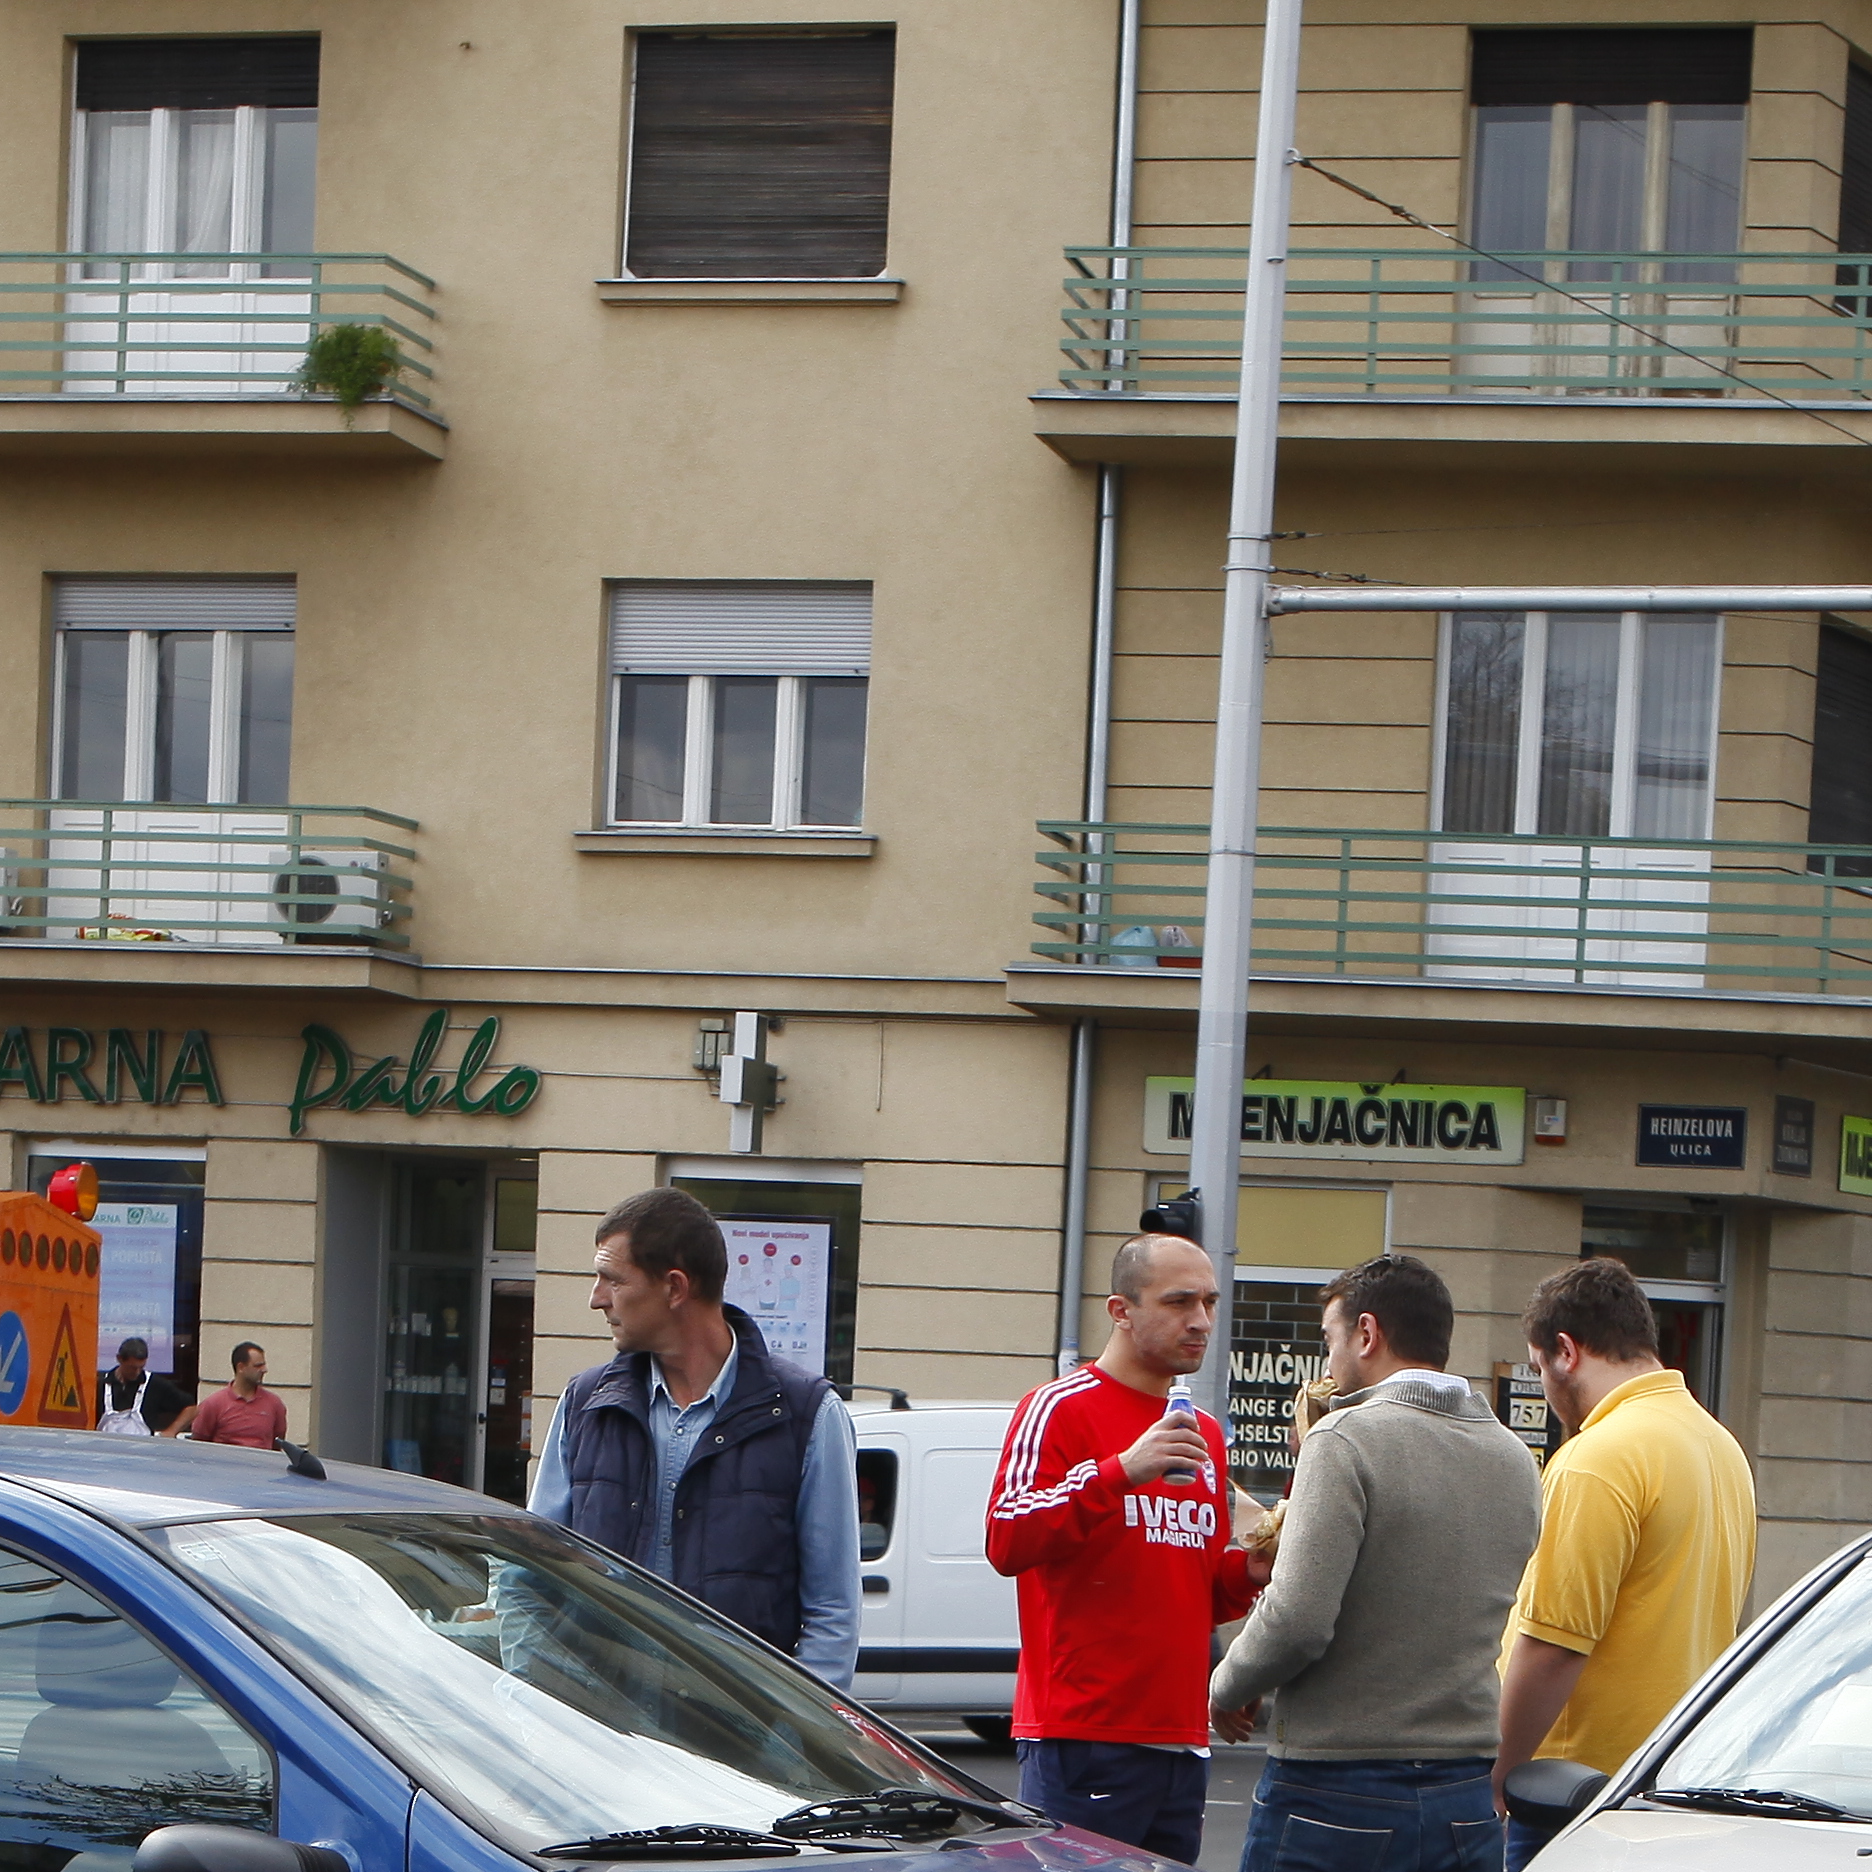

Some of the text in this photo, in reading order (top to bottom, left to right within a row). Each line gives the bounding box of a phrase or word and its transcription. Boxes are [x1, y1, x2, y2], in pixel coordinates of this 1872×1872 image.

[288, 1007, 544, 1137] Pablo
[1167, 1082, 1503, 1151] MENJAČNICA
[1650, 1117, 1733, 1138] HEINZELOVA
[1669, 1144, 1712, 1157] ULICA
[94, 1213, 121, 1223] ARNA
[1230, 1344, 1329, 1385] NJAČNI
[1228, 1397, 1277, 1418] ANGE
[1512, 1404, 1546, 1424] 757
[1233, 1422, 1291, 1445] HSELST
[1123, 1494, 1217, 1537] IVECO
